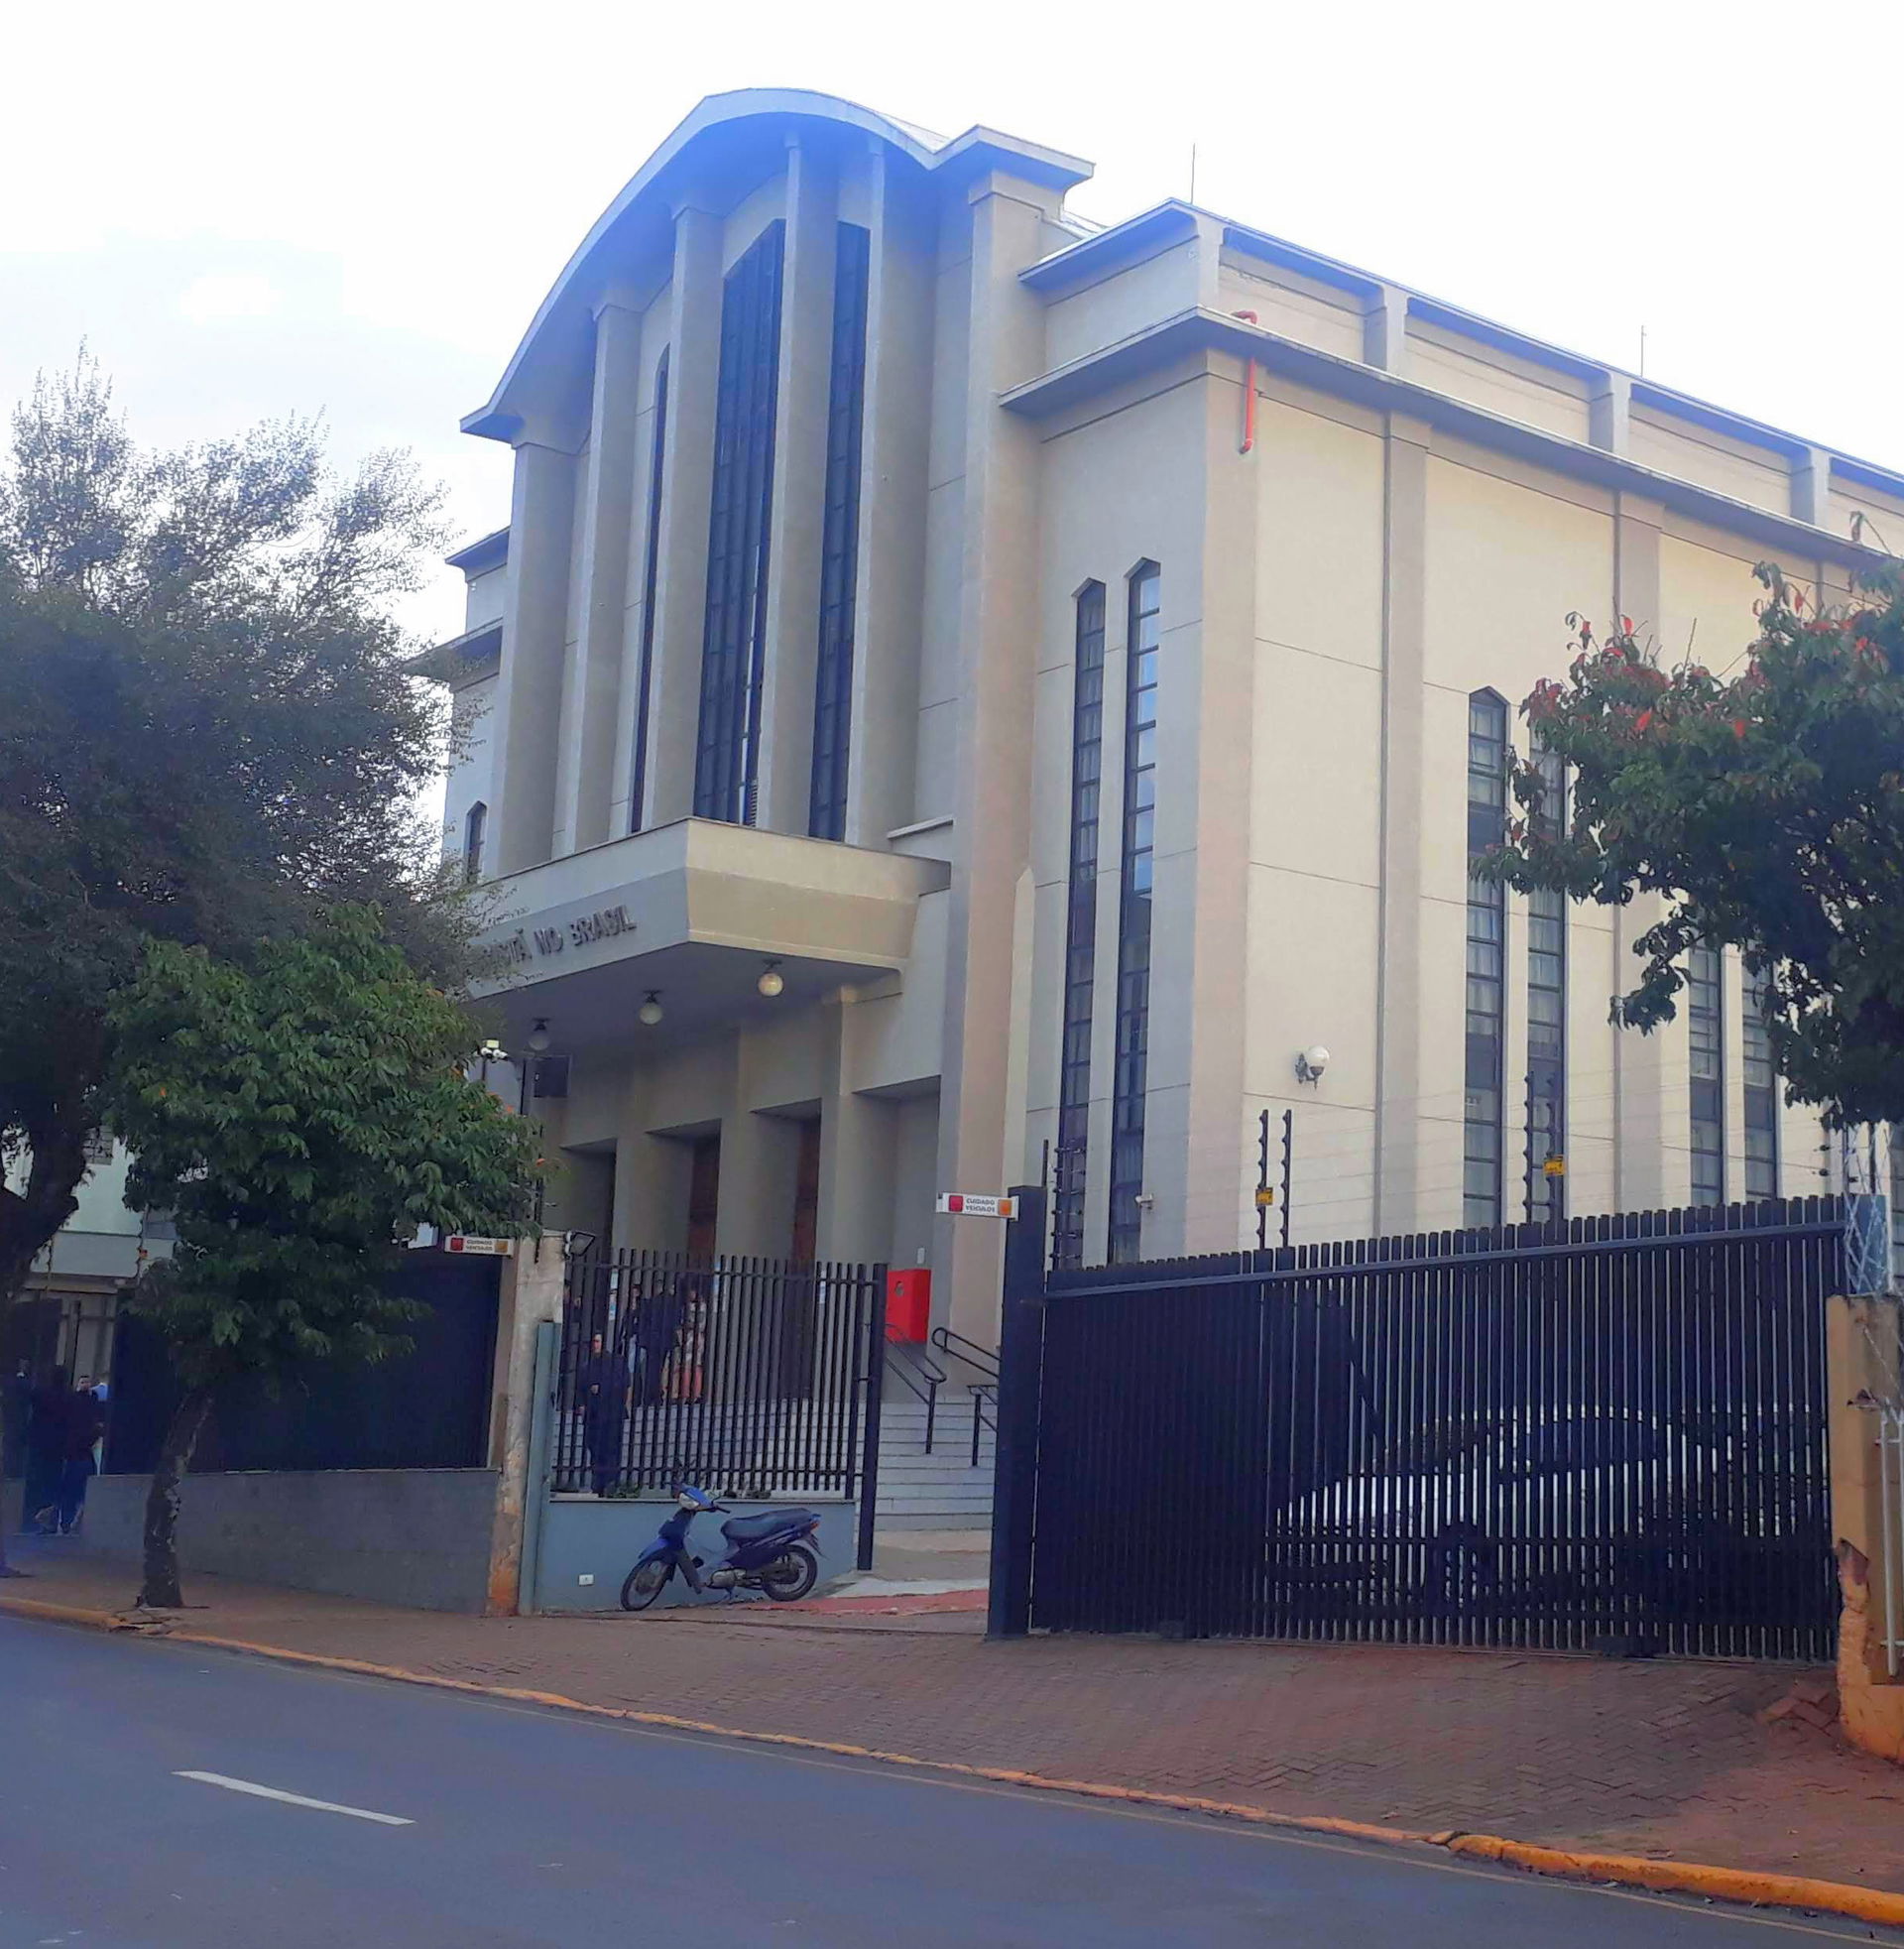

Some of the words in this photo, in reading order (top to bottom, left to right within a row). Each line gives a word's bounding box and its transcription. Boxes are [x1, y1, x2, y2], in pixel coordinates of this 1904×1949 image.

[534, 926, 564, 955] NO
[569, 905, 637, 946] BRASIL
[966, 1197, 996, 1206] CUIDADO
